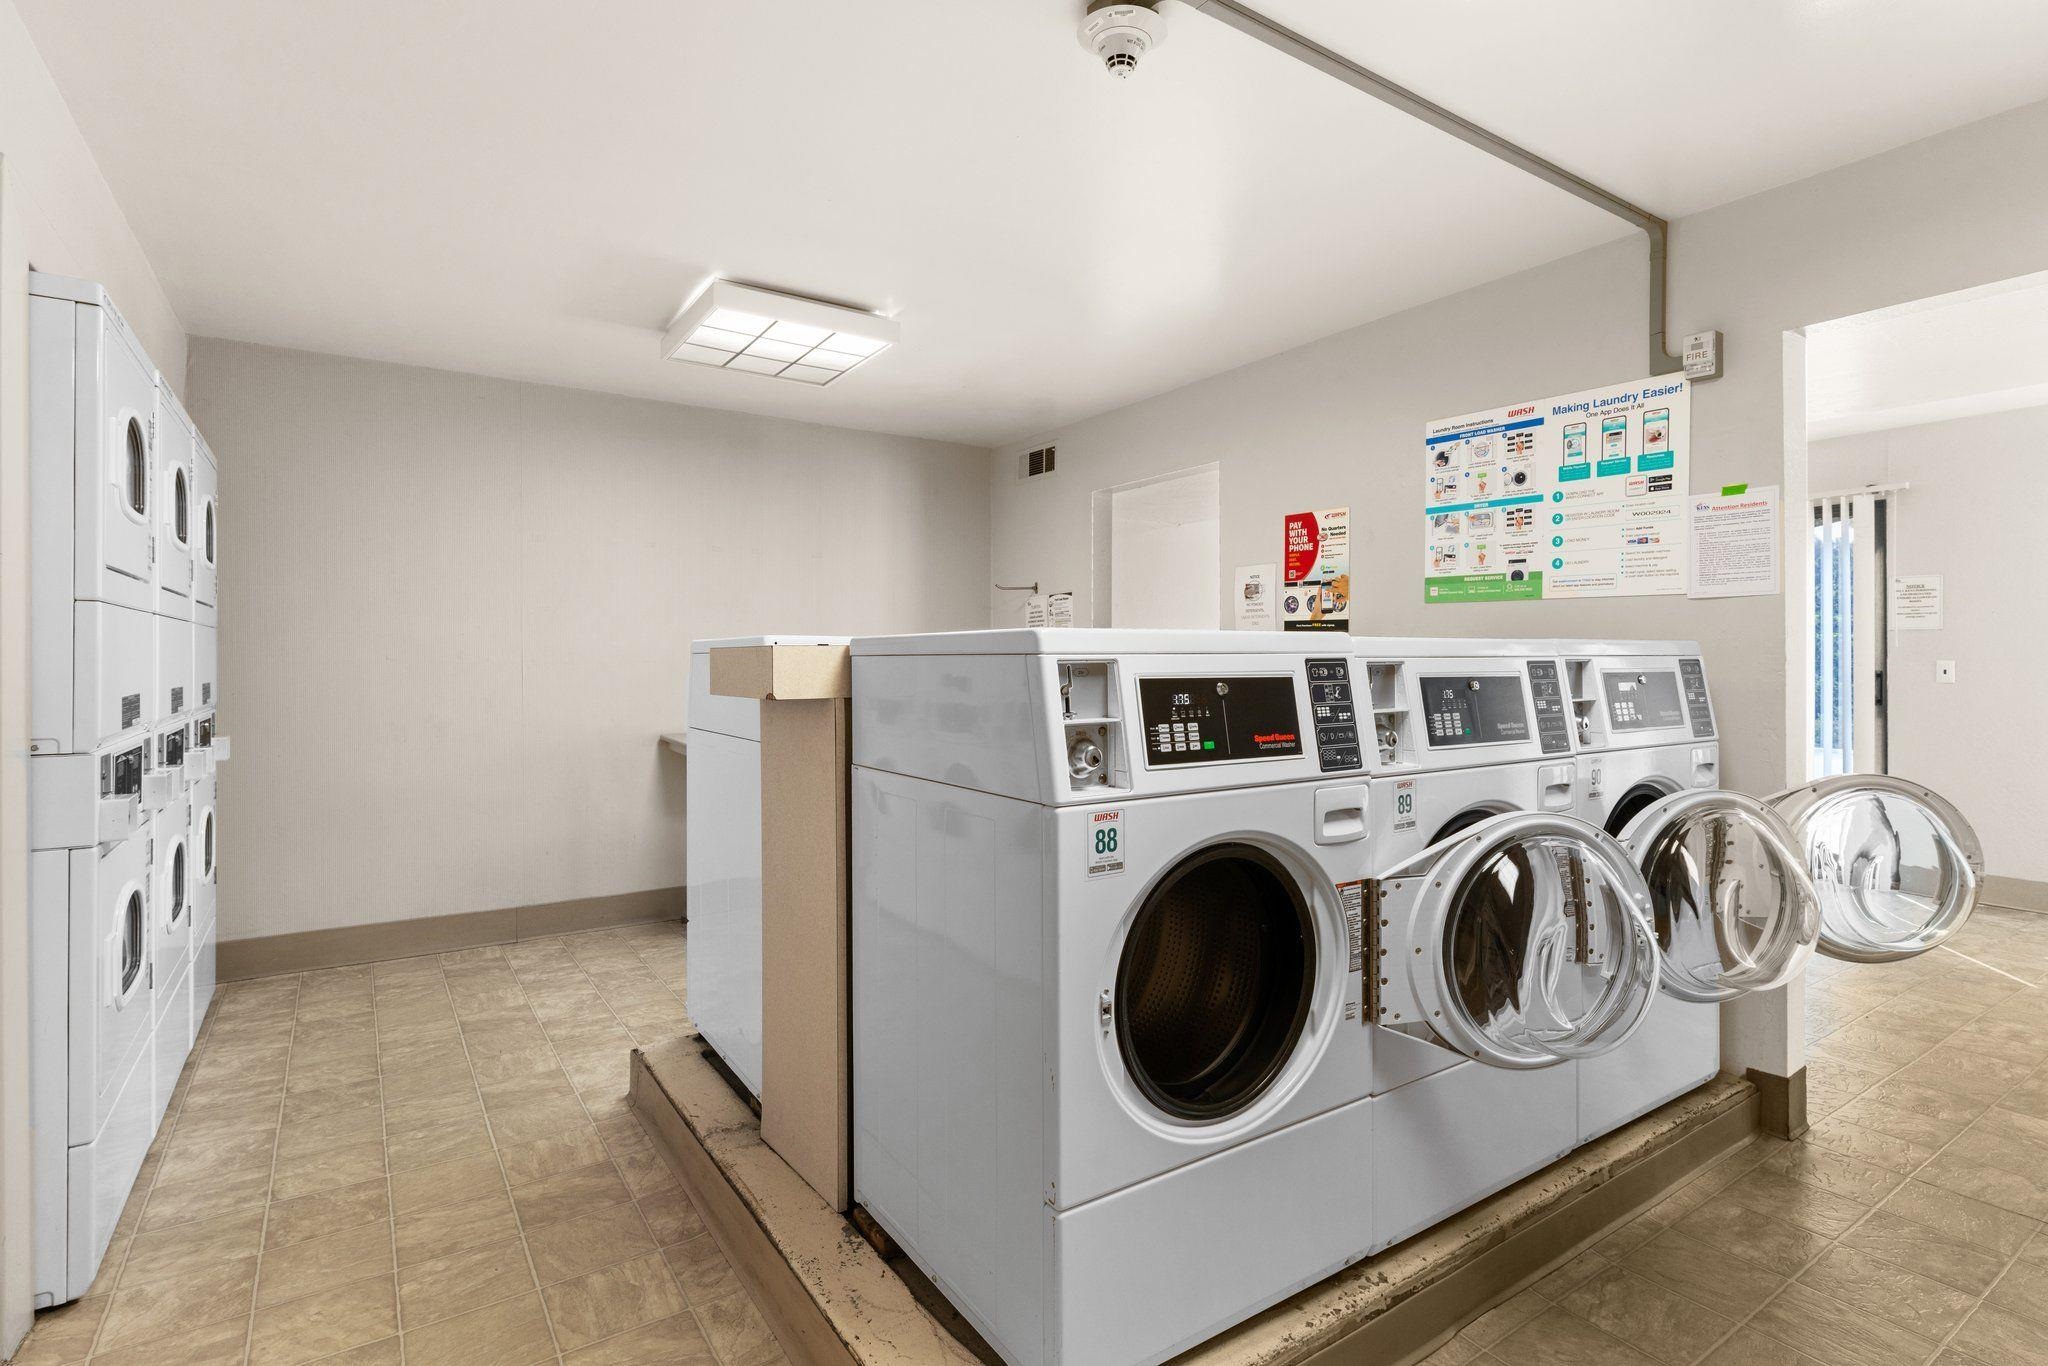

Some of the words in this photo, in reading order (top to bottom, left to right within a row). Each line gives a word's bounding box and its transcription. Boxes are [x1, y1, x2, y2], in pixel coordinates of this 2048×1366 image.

[1687, 350, 1708, 361] FIRE
[1552, 402, 1589, 416] Making
[1593, 393, 1638, 408] Laundry
[1642, 382, 1683, 399] Easier!
[1508, 406, 1535, 417] WASH
[1600, 409, 1612, 417] App
[1613, 406, 1629, 414] Does
[1433, 425, 1451, 434] Laundry
[1466, 418, 1494, 427] Instructions
[1289, 521, 1302, 530] PAY
[1289, 528, 1307, 537] WITH
[1289, 536, 1308, 545] YOUR
[1289, 543, 1314, 552] PHONE
[1254, 734, 1275, 742] Speed
[1275, 733, 1296, 741] Queen
[1591, 768, 1602, 785] 90
[1397, 781, 1413, 789] WASH
[1398, 793, 1412, 814] 89
[1094, 812, 1119, 821] WASH
[1095, 827, 1118, 854] 88
